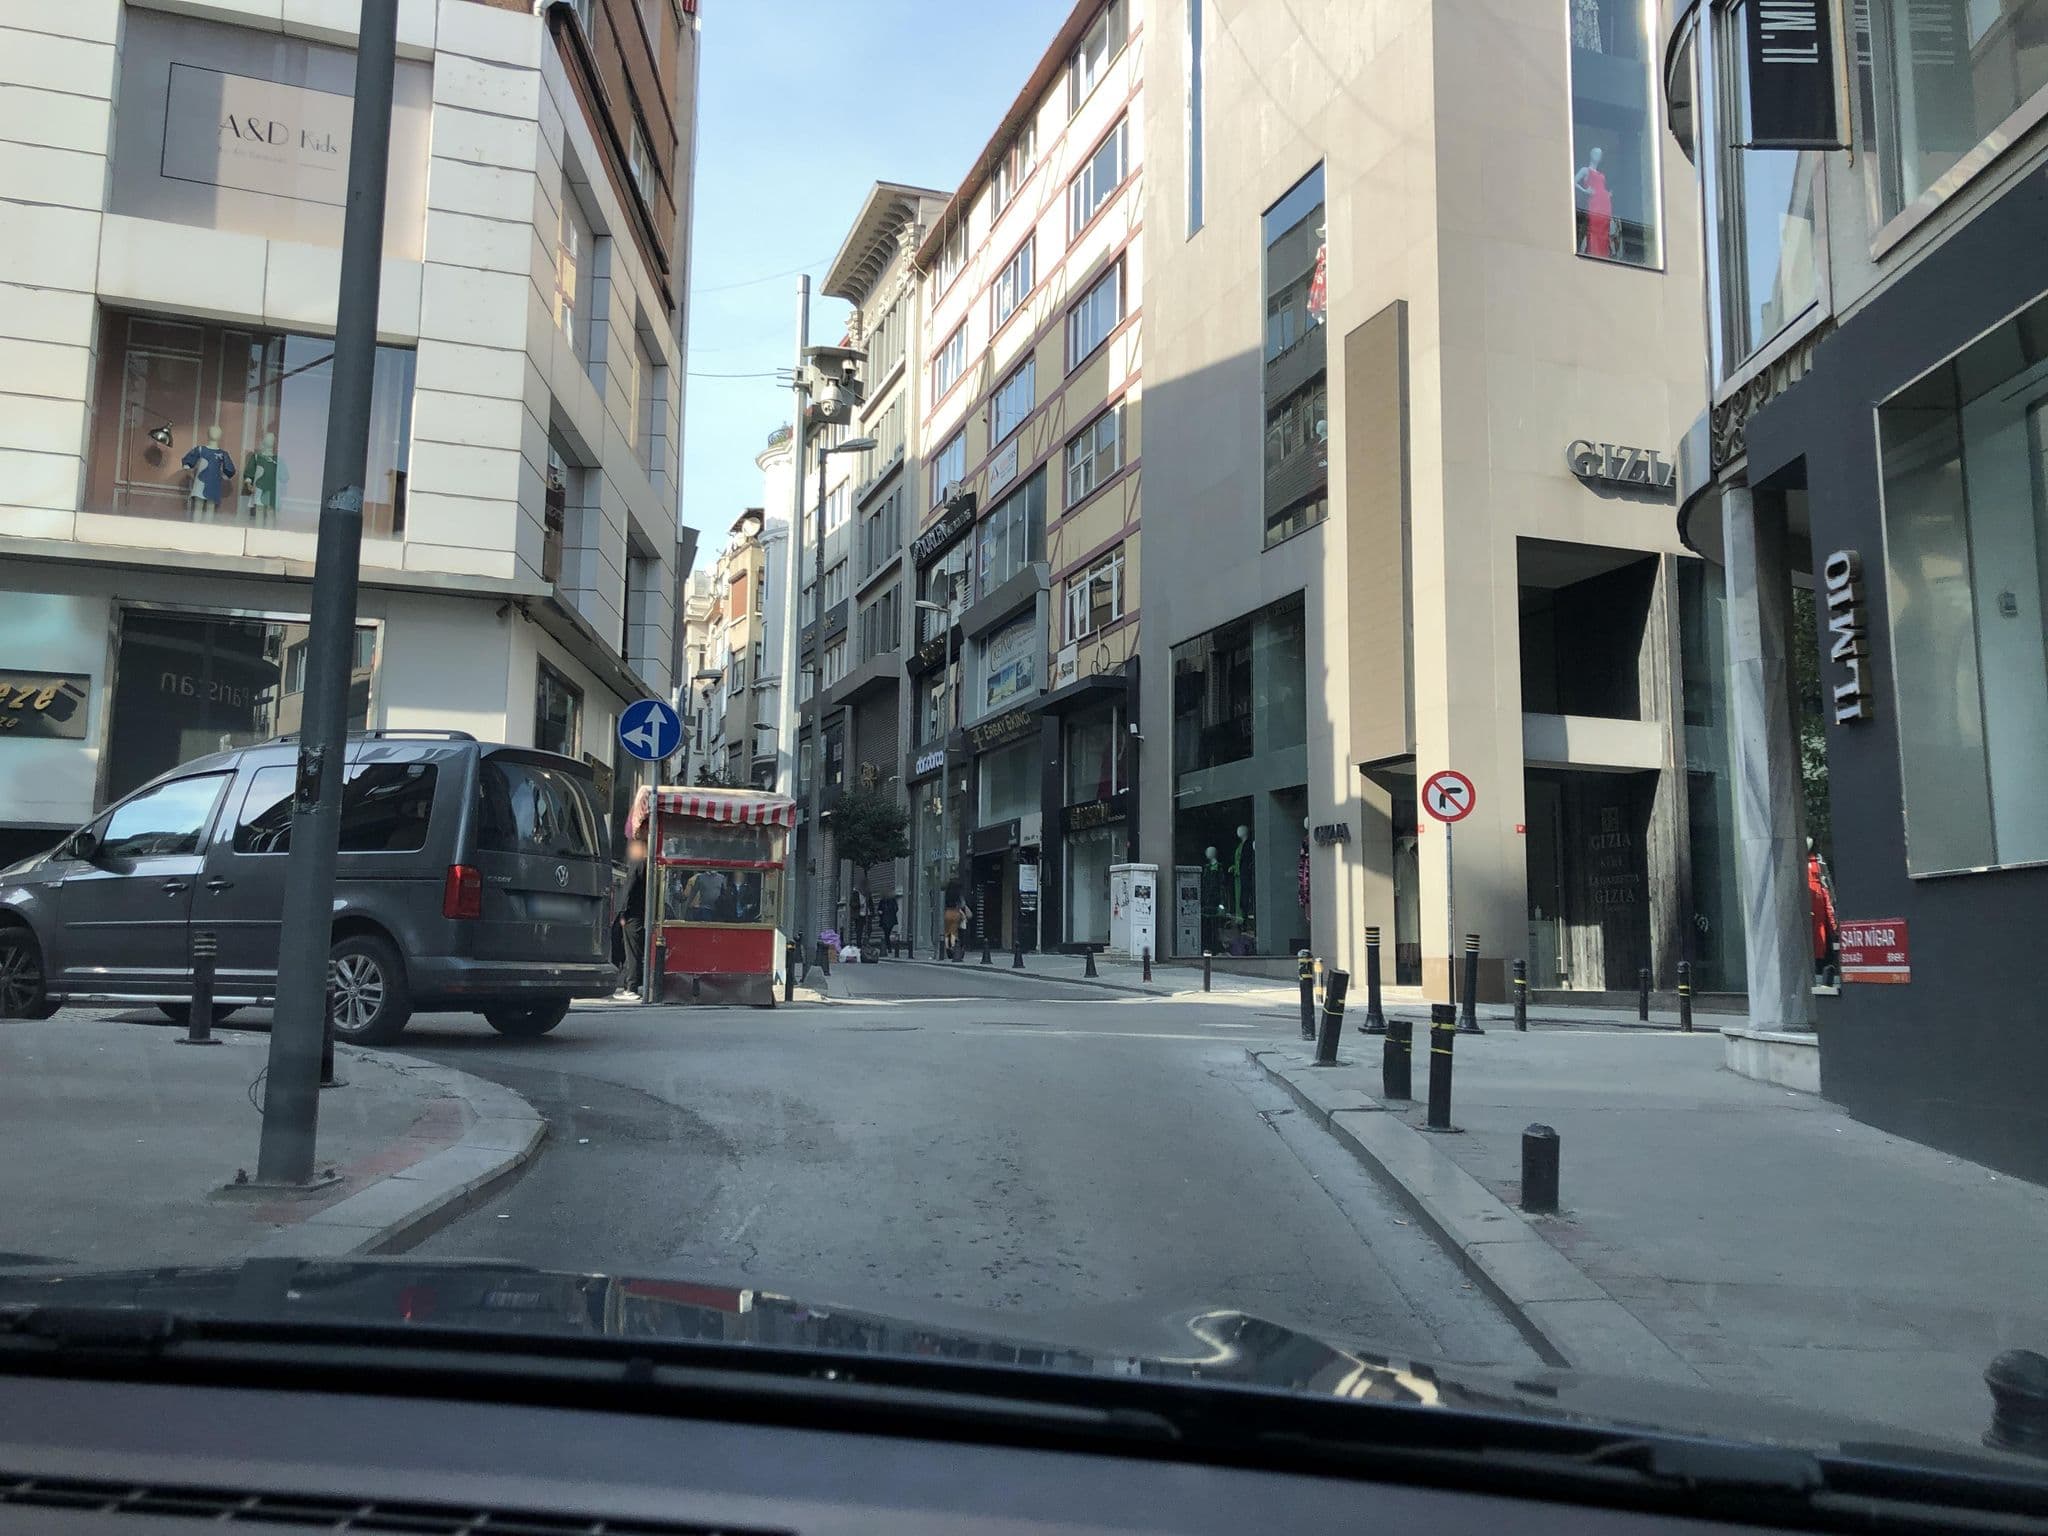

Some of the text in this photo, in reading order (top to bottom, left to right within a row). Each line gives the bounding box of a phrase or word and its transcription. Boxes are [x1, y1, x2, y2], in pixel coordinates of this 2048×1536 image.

[219, 114, 337, 153] A&D Kids
[1841, 926, 1896, 950] ŞAİR NİGAR
